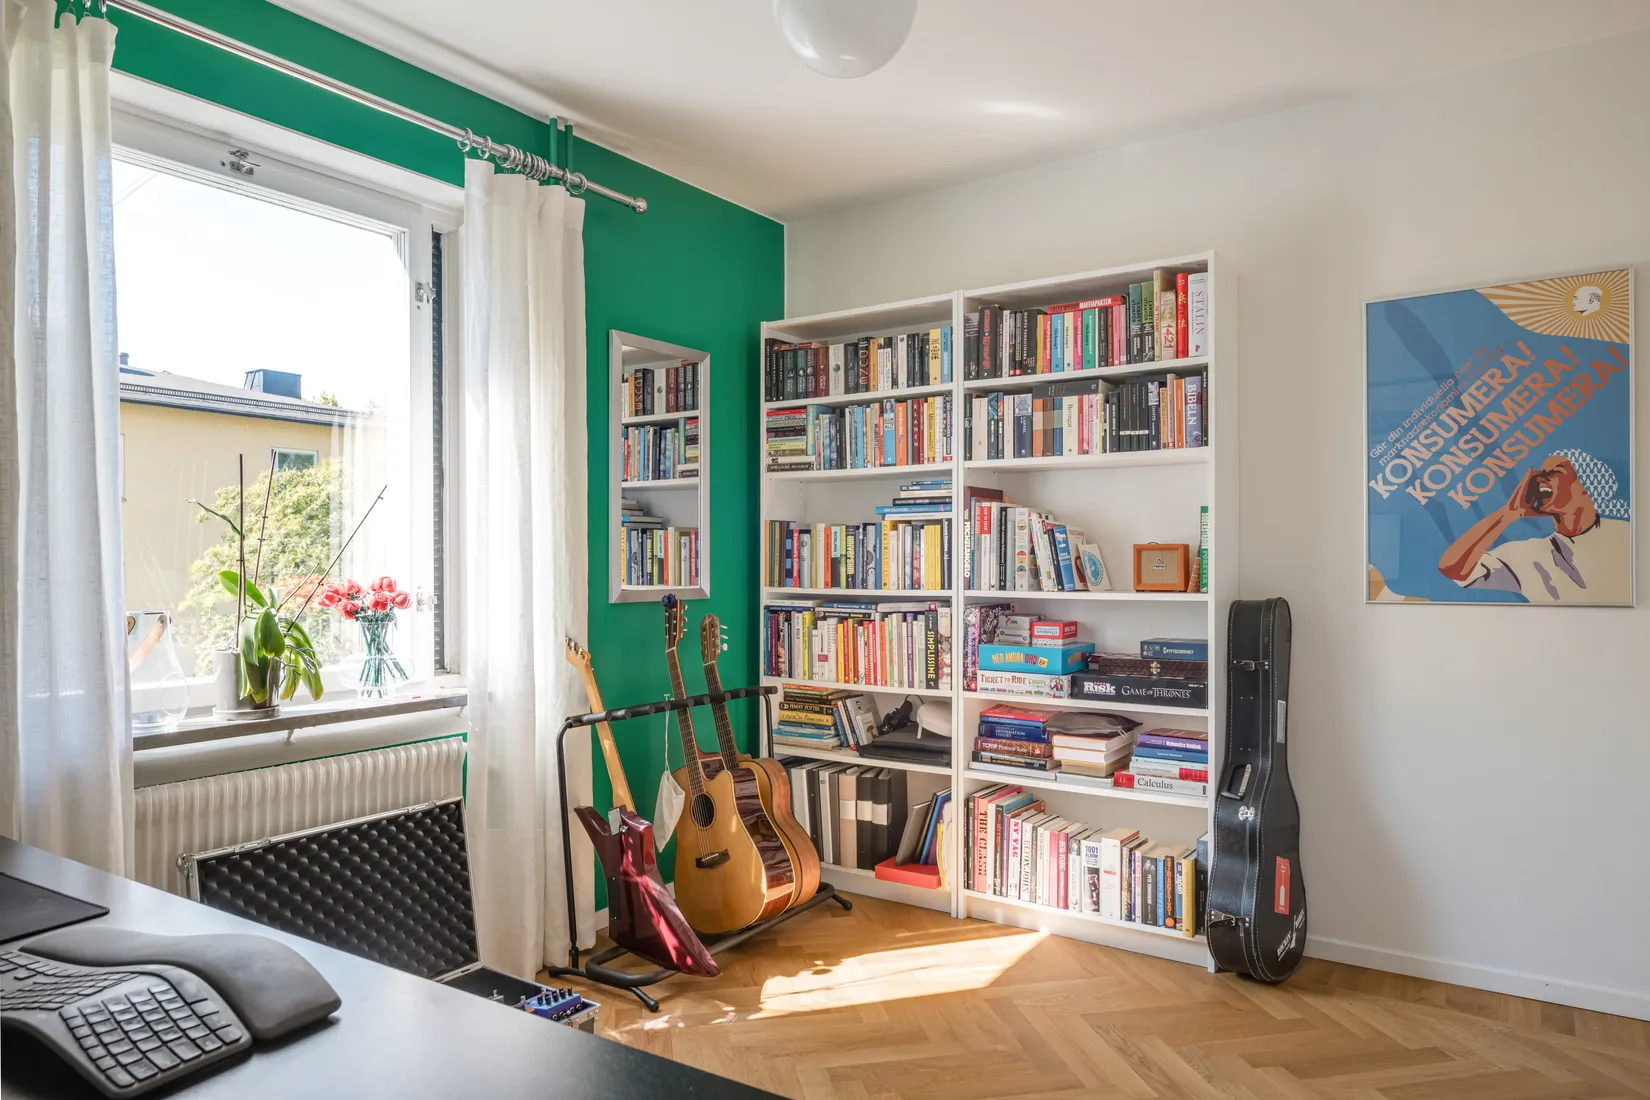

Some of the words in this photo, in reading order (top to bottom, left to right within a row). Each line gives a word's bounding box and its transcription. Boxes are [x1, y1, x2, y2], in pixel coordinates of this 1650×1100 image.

[1196, 291, 1204, 335] STALIN
[1163, 324, 1174, 348] 1421
[1188, 384, 1197, 425] BIBELN
[1369, 340, 1536, 499] KONSUMERA!
[1370, 441, 1387, 458] Gör
[1388, 427, 1404, 442] din
[1402, 378, 1455, 428] individuella
[1454, 357, 1474, 379] plikt
[1379, 380, 1469, 466] marknadsekonomins
[1406, 344, 1580, 505] KONSUMERA!
[1448, 346, 1629, 510] KONSUMERA!
[927, 631, 935, 679] SIMPLISSIME
[992, 653, 1004, 664] MED
[1006, 652, 1024, 663] ANDRA
[1025, 653, 1038, 665] ORD
[1163, 646, 1194, 655] CRYPTOCURRENCY
[980, 674, 1003, 683] TICKET
[1012, 676, 1027, 685] RIDE
[1121, 686, 1146, 696] GAME
[1152, 687, 1192, 698] THRONES
[1138, 778, 1174, 789] Calculus
[979, 811, 987, 834] THE
[1013, 821, 1019, 834] NY
[978, 838, 987, 876] CLASH
